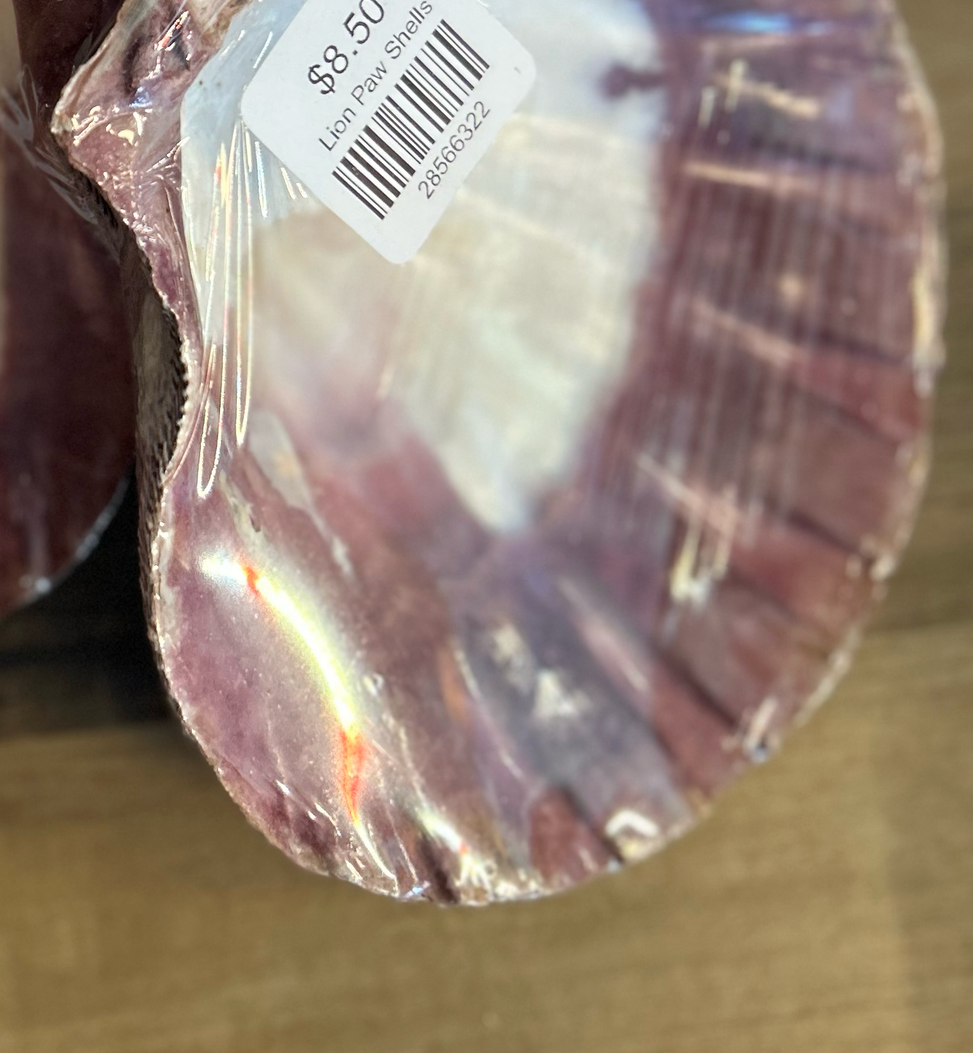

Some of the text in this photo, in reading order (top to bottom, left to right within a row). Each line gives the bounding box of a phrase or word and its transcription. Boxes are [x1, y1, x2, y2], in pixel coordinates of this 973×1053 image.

[318, 0, 434, 152] Lion Paw Shells
[417, 100, 491, 200] 28566322
